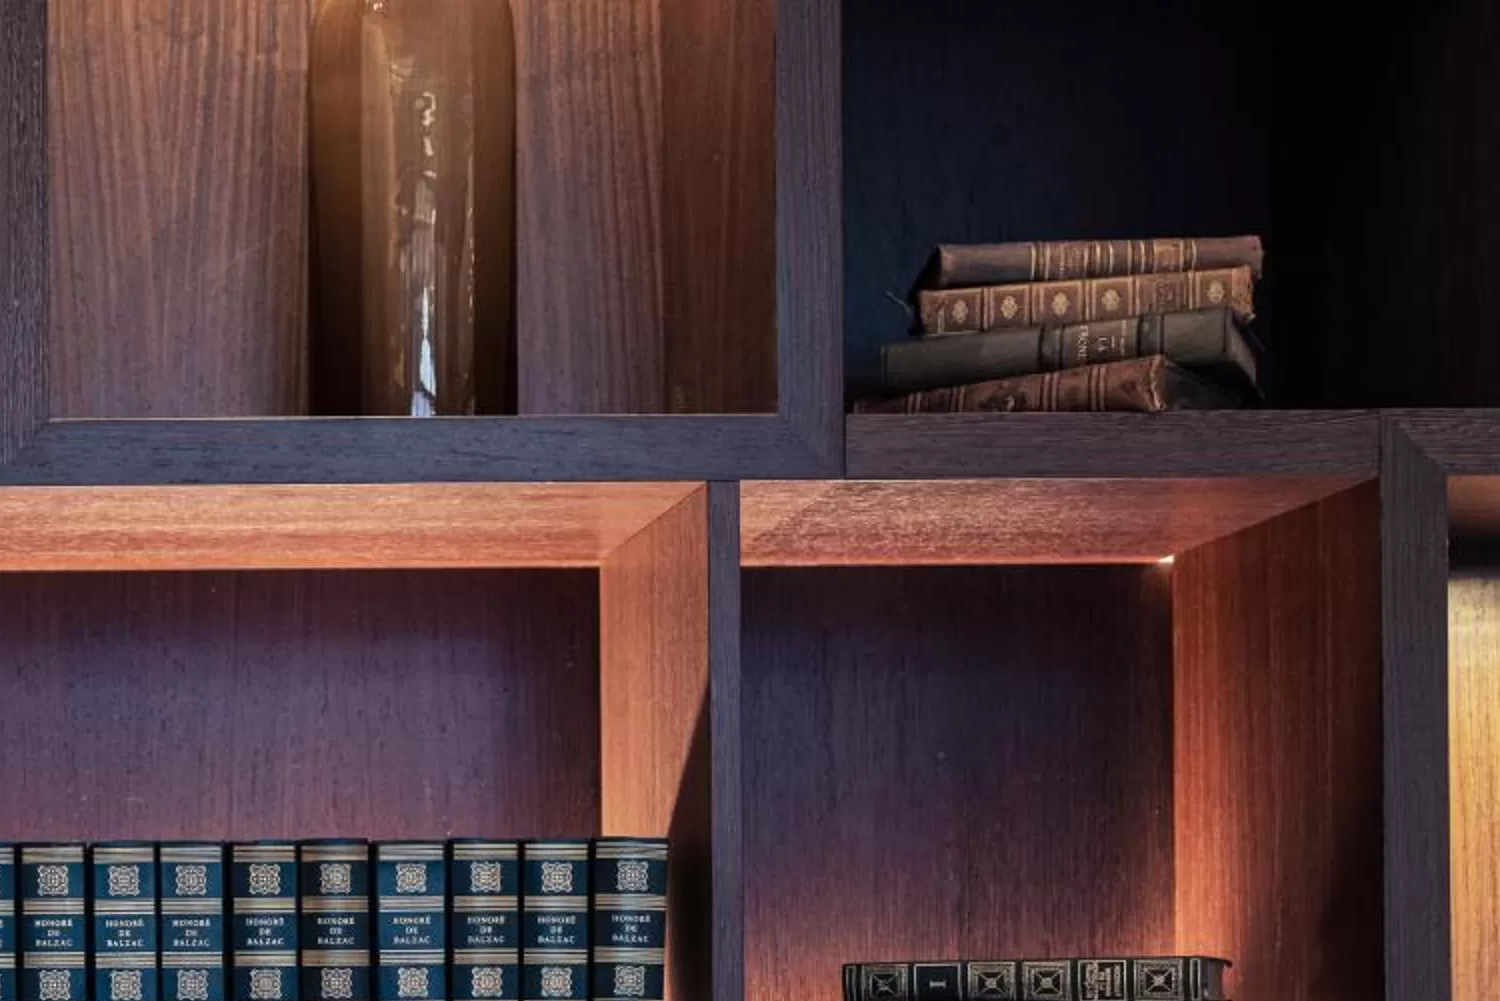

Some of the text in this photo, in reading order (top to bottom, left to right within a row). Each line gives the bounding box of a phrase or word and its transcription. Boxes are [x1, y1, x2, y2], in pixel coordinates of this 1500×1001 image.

[246, 937, 285, 946] BALZAC
[317, 936, 355, 945] BALZAC
[393, 936, 431, 945] BALZAC
[467, 935, 505, 944] BALZAC
[537, 935, 575, 944] BALZAC
[612, 934, 649, 943] BALZAC
[35, 939, 73, 948] BALZAC
[106, 939, 143, 948] BALZAC
[172, 939, 211, 948] BALZAC
